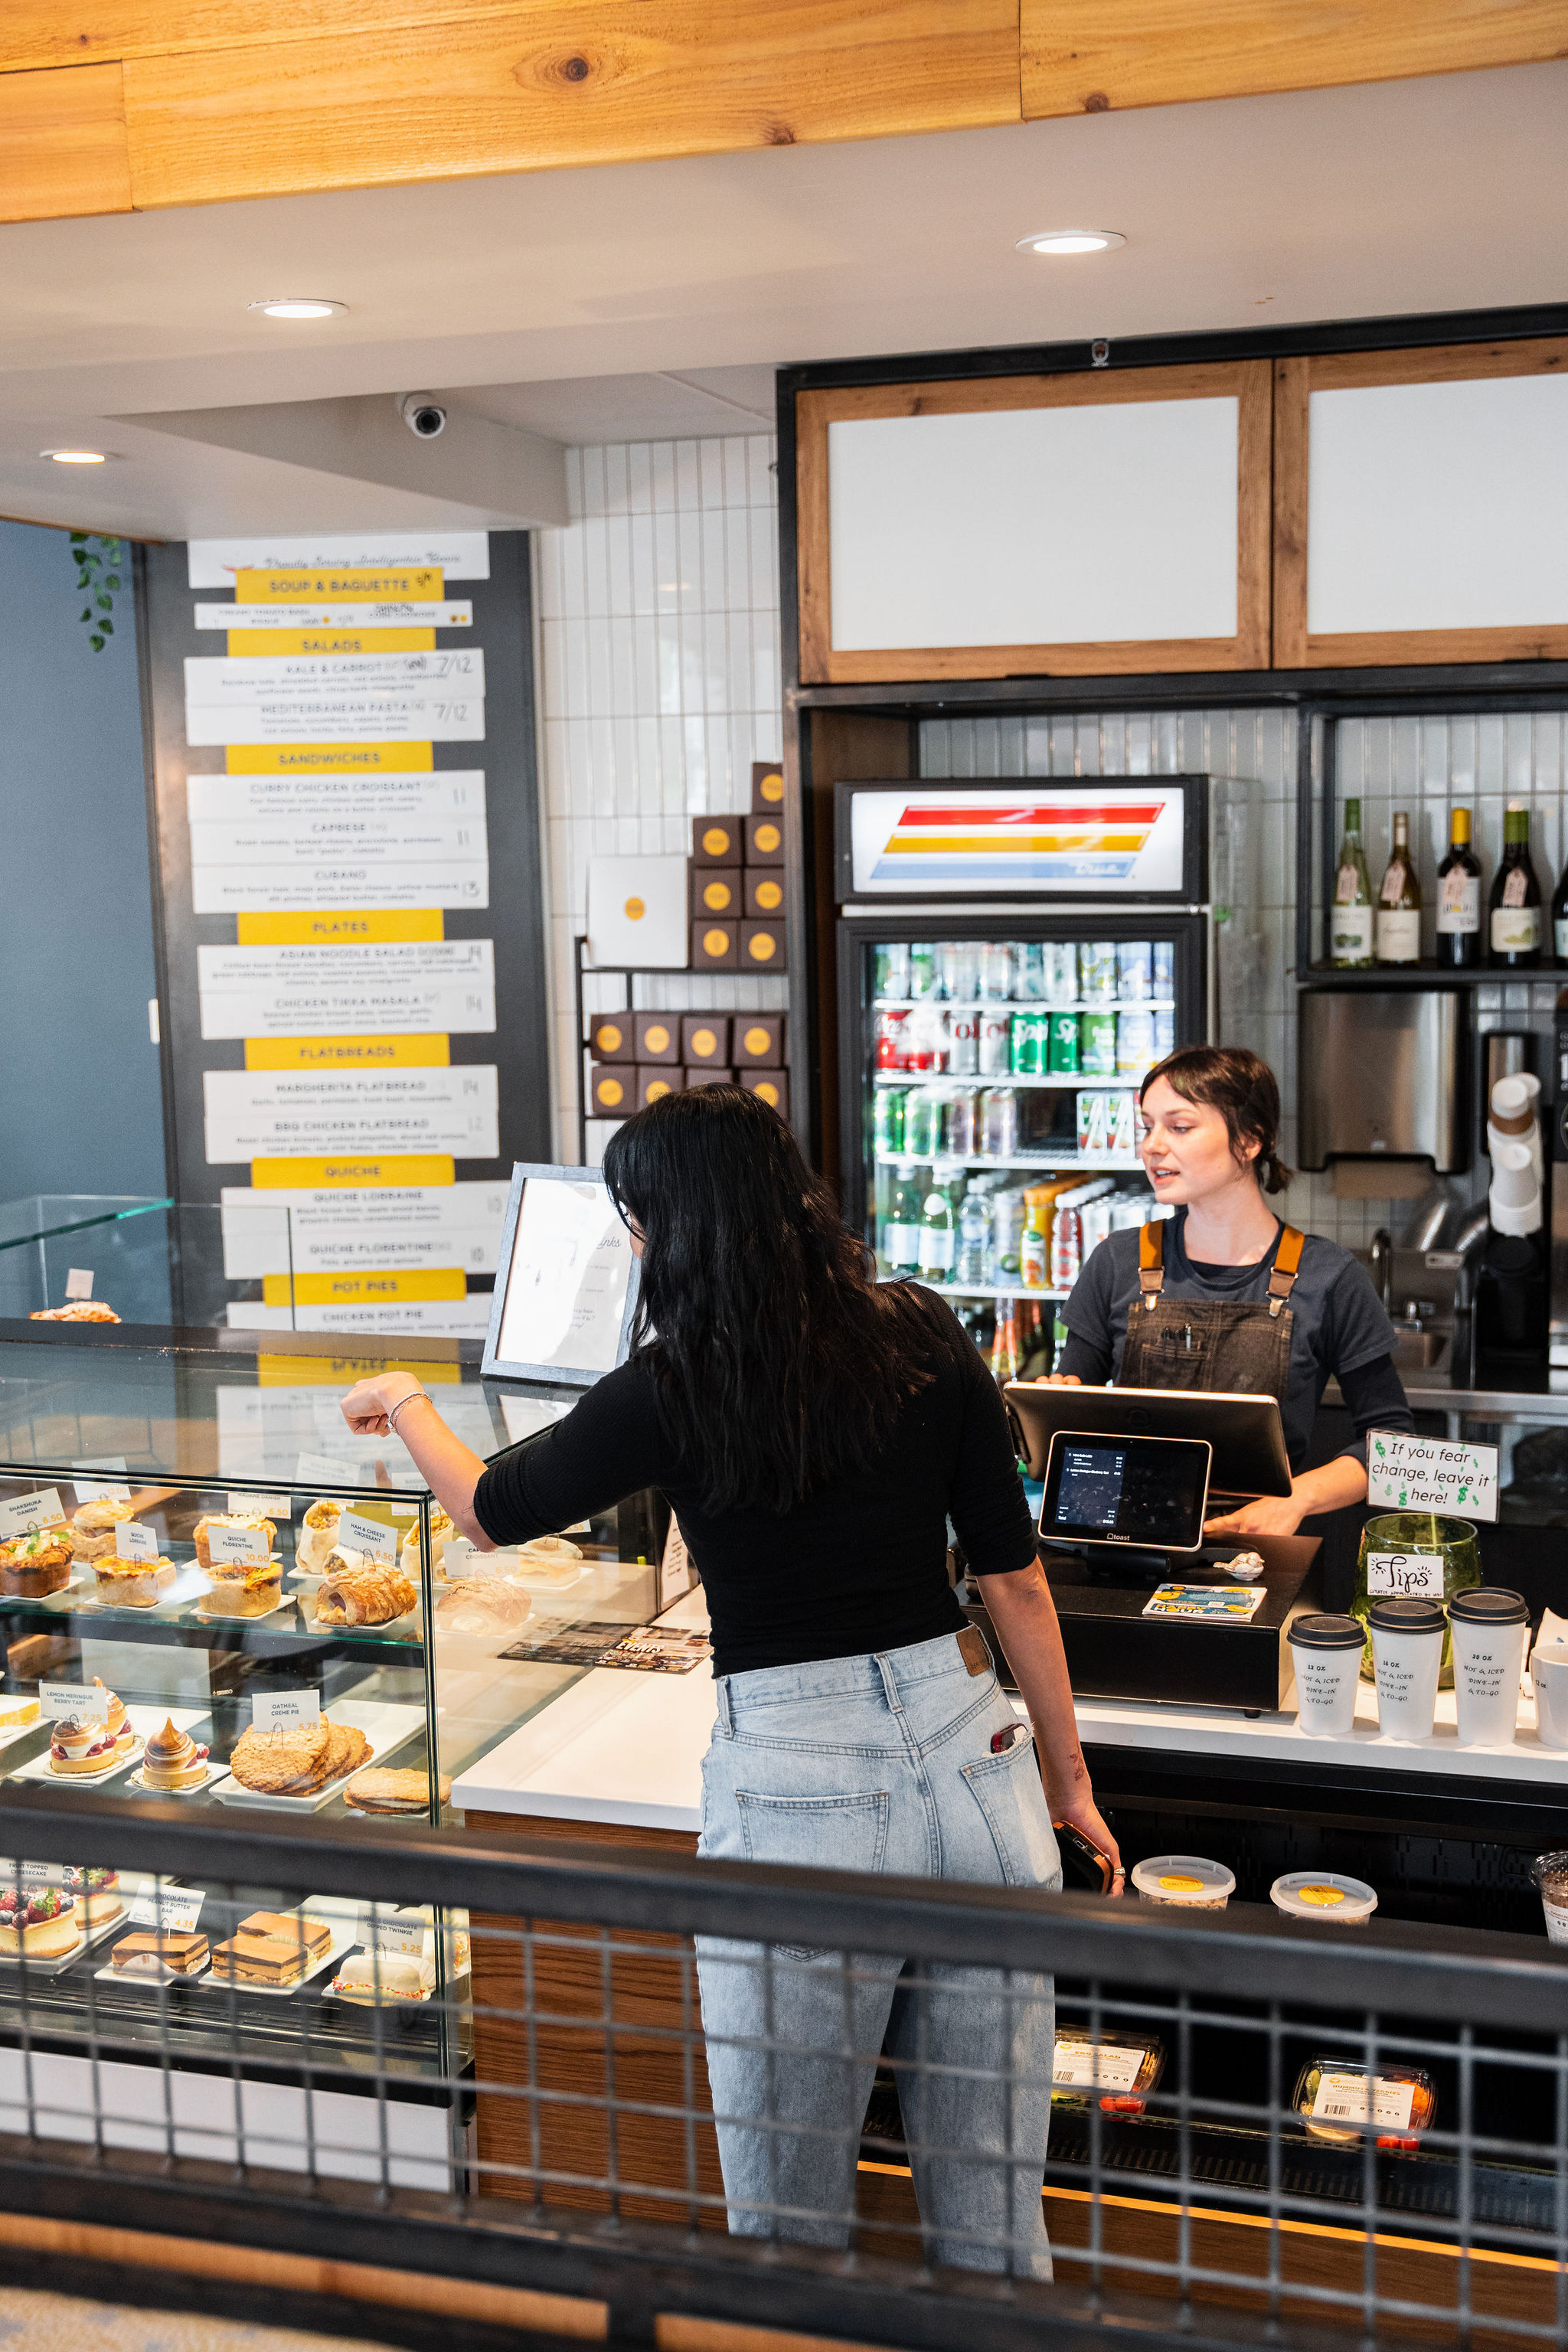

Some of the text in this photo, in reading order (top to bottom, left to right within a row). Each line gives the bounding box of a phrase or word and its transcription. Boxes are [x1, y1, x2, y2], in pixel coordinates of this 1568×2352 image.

[270, 580, 311, 593] SOUP
[316, 580, 325, 592] &
[330, 578, 410, 593] BAGUETTE
[302, 639, 362, 652] SALADS
[277, 752, 382, 766] SANDWICHES
[312, 921, 370, 933] PLATES
[299, 1045, 396, 1059] FLATBREADS
[325, 1165, 382, 1178] QUICHE
[332, 1279, 399, 1293] POT PIES
[322, 1308, 423, 1322] CHICKEN POT PIE
[1390, 1442, 1470, 1463] If you fear
[1372, 1462, 1490, 1487] change, leave it
[1410, 1488, 1449, 1504] here!
[8, 1500, 42, 1511] SHAKSHUKA
[17, 1507, 38, 1516] DANISH
[42, 1513, 63, 1524] 6.50
[269, 1508, 288, 1517] 6.50
[351, 1523, 362, 1531] HAM
[367, 1528, 386, 1539] CHEESE
[354, 1530, 381, 1543] CROISSANT
[222, 1541, 253, 1550] FLORENTINE
[246, 1553, 270, 1563] 10.00
[375, 1549, 394, 1562] 6.50
[1376, 1555, 1429, 1593] Tips
[615, 1640, 665, 1654] EVENTS
[1380, 1681, 1408, 1691] DINE-IN
[1468, 1677, 1501, 1686] DINE-IN
[1386, 1693, 1408, 1702] TO-GO
[1475, 1689, 1499, 1697] TO-GO
[82, 1713, 102, 1722] 7.25
[298, 1722, 318, 1731] 5.75
[170, 1902, 191, 1910] BUTTER
[175, 1918, 194, 1929] 4.35
[383, 1918, 418, 1930] CHOCOLATE
[388, 1926, 413, 1936] TWINKIE
[401, 1942, 422, 1954] 5.25
